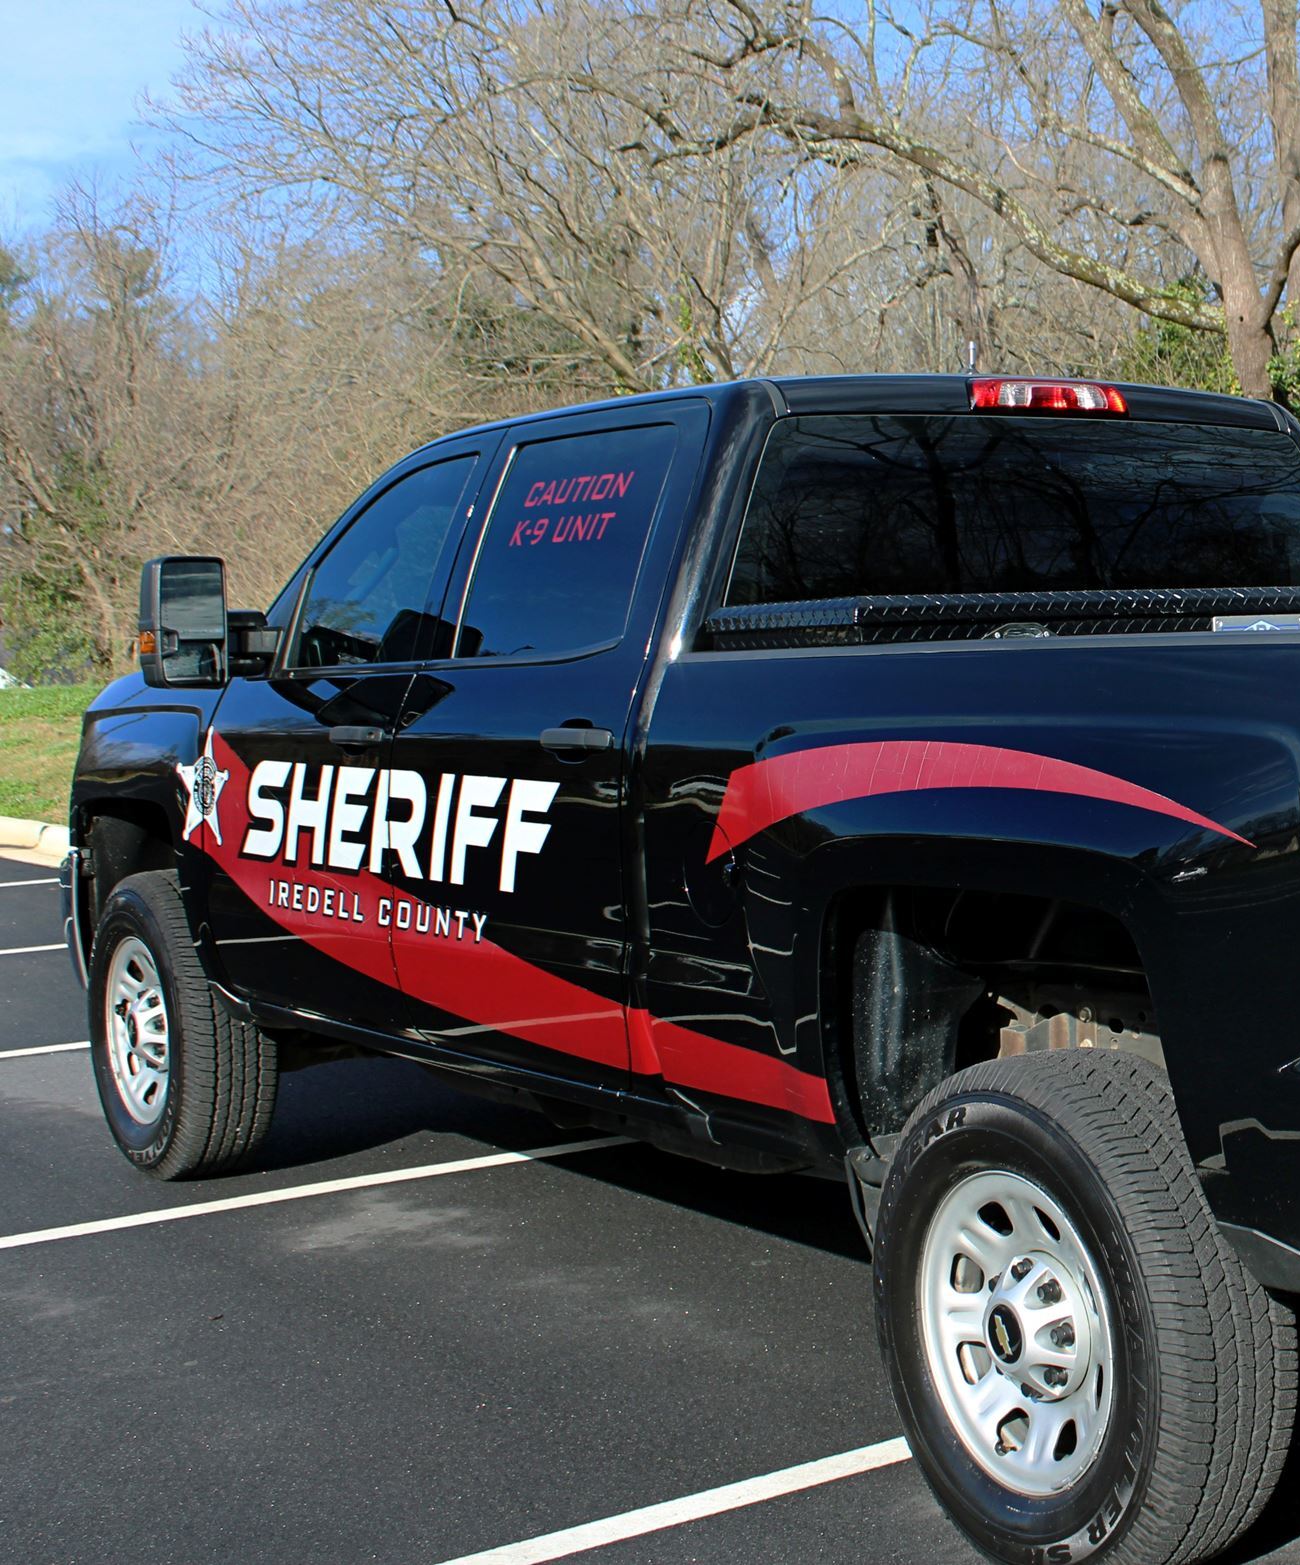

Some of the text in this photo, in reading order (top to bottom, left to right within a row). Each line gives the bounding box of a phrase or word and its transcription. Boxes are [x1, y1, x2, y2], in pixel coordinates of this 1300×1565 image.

[524, 471, 635, 508] CAUTION
[509, 512, 616, 546] K-9 UNIT
[242, 760, 560, 893] SHERIFF
[268, 879, 487, 943] IREDELL COUNTY
